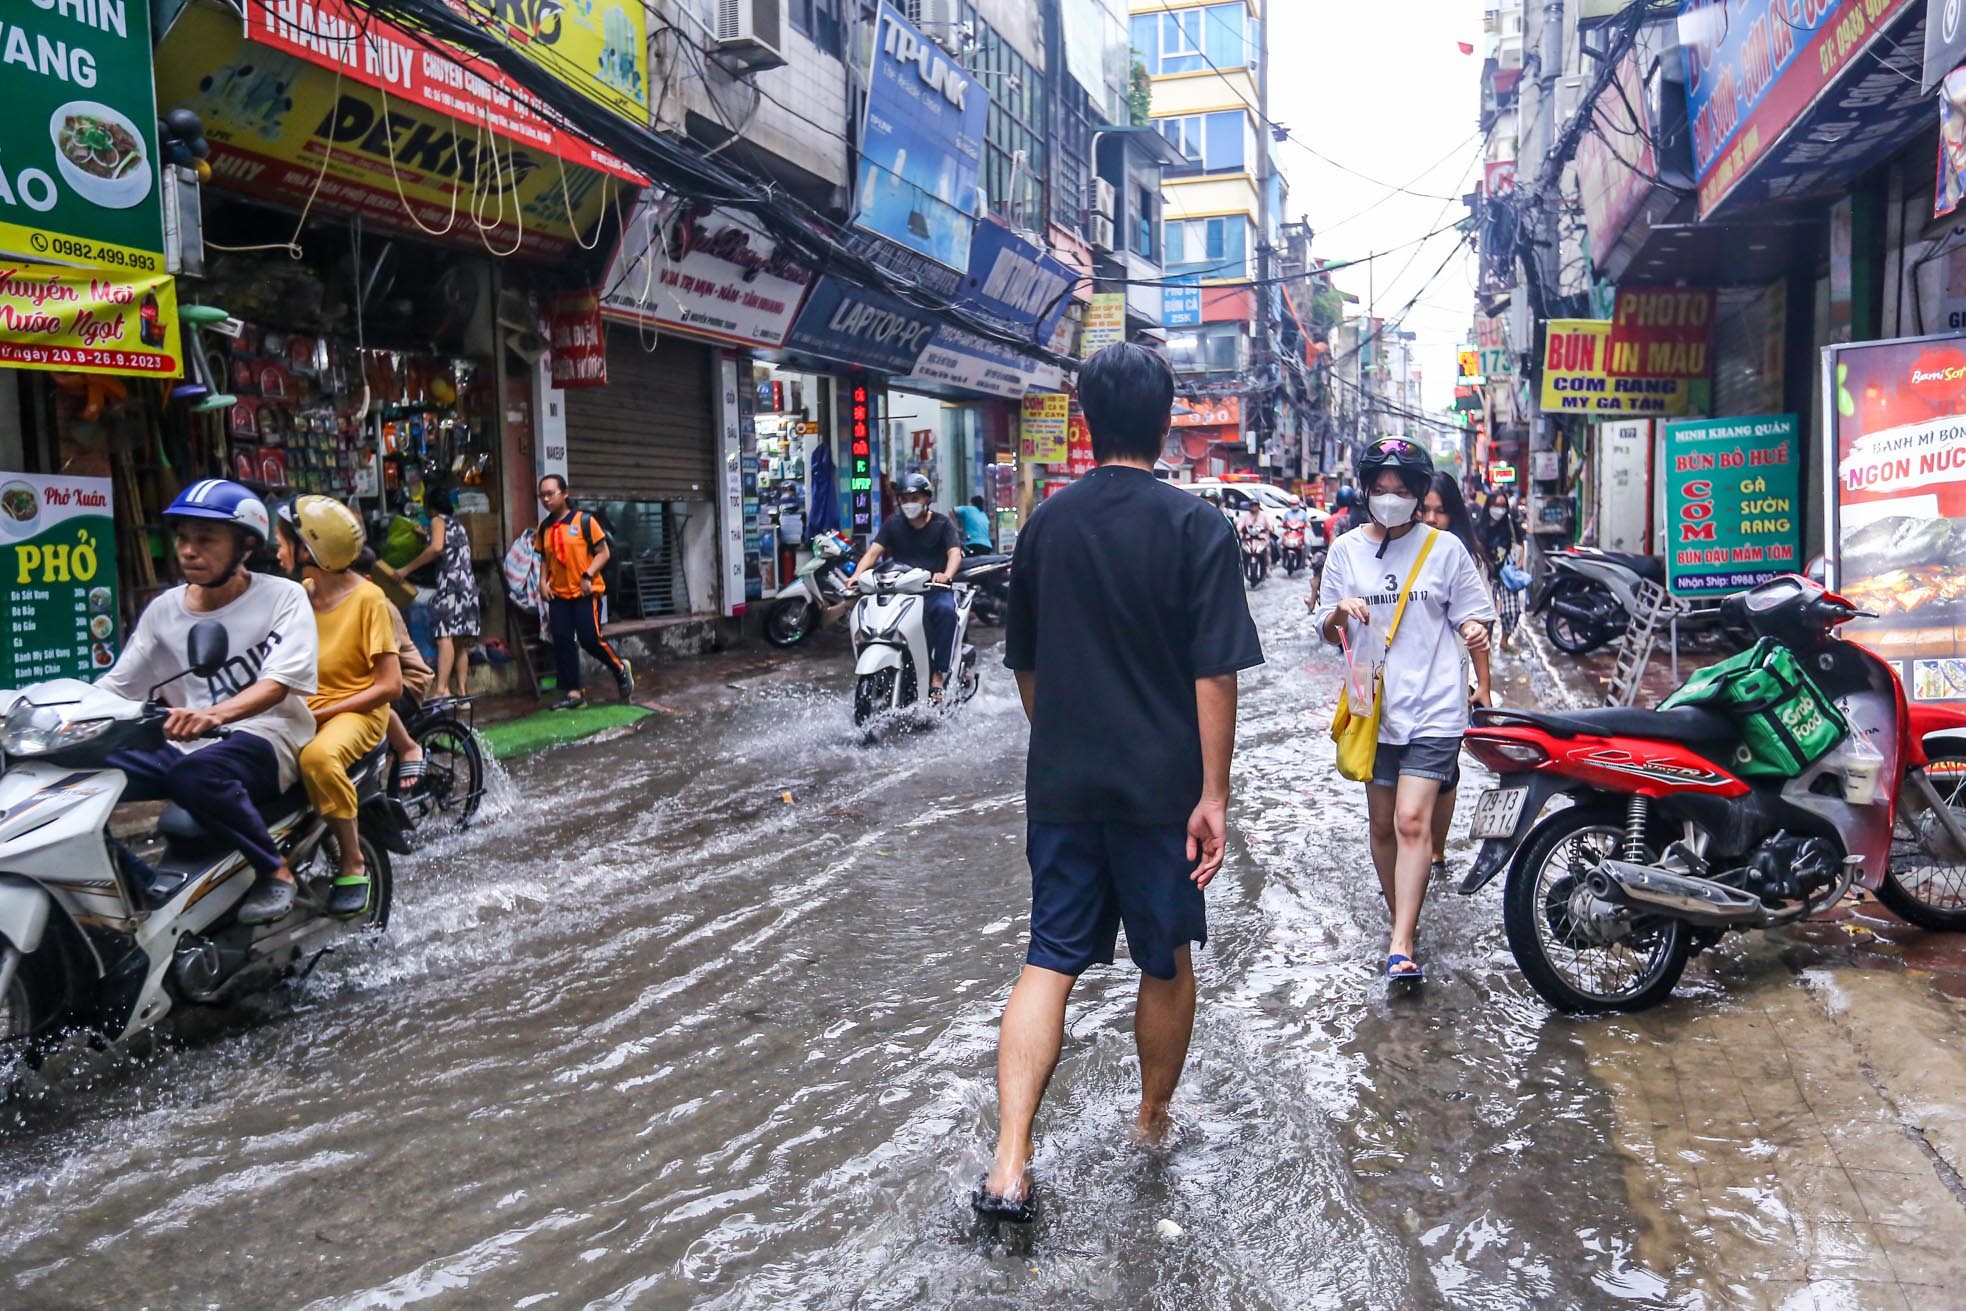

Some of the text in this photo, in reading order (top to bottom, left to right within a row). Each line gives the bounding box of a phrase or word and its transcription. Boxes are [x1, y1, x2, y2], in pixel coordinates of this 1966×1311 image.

[0, 21, 97, 88] ANG
[363, 30, 414, 89] HUY
[52, 238, 155, 271] 0982.499.993
[1619, 292, 1710, 327] PHOTO
[67, 307, 125, 347] Ngọt
[1547, 327, 1596, 372] BÚN
[1647, 335, 1706, 373] MÀU
[1553, 376, 1678, 394] CƠM RANG
[1675, 429, 1706, 443] MINH
[1708, 425, 1751, 440] KHANG
[1675, 440, 1791, 472] BÚN BÒ HUẾ
[1740, 476, 1766, 493] GÀ
[1848, 456, 1911, 489] NGON
[44, 485, 108, 508] Phở Xuân
[1740, 496, 1790, 515] SƯỜN
[1740, 519, 1791, 534] RANG
[15, 528, 98, 584] PHỞ
[1677, 548, 1702, 565] BÚN
[1705, 549, 1730, 568] ĐẬU
[1384, 574, 1399, 592] 3
[1677, 576, 1705, 590] Nhận
[1706, 574, 1729, 588] Ship:
[1782, 696, 1815, 726] Grab
[1792, 713, 1823, 744] Food
[1481, 791, 1519, 812] 29-Y3
